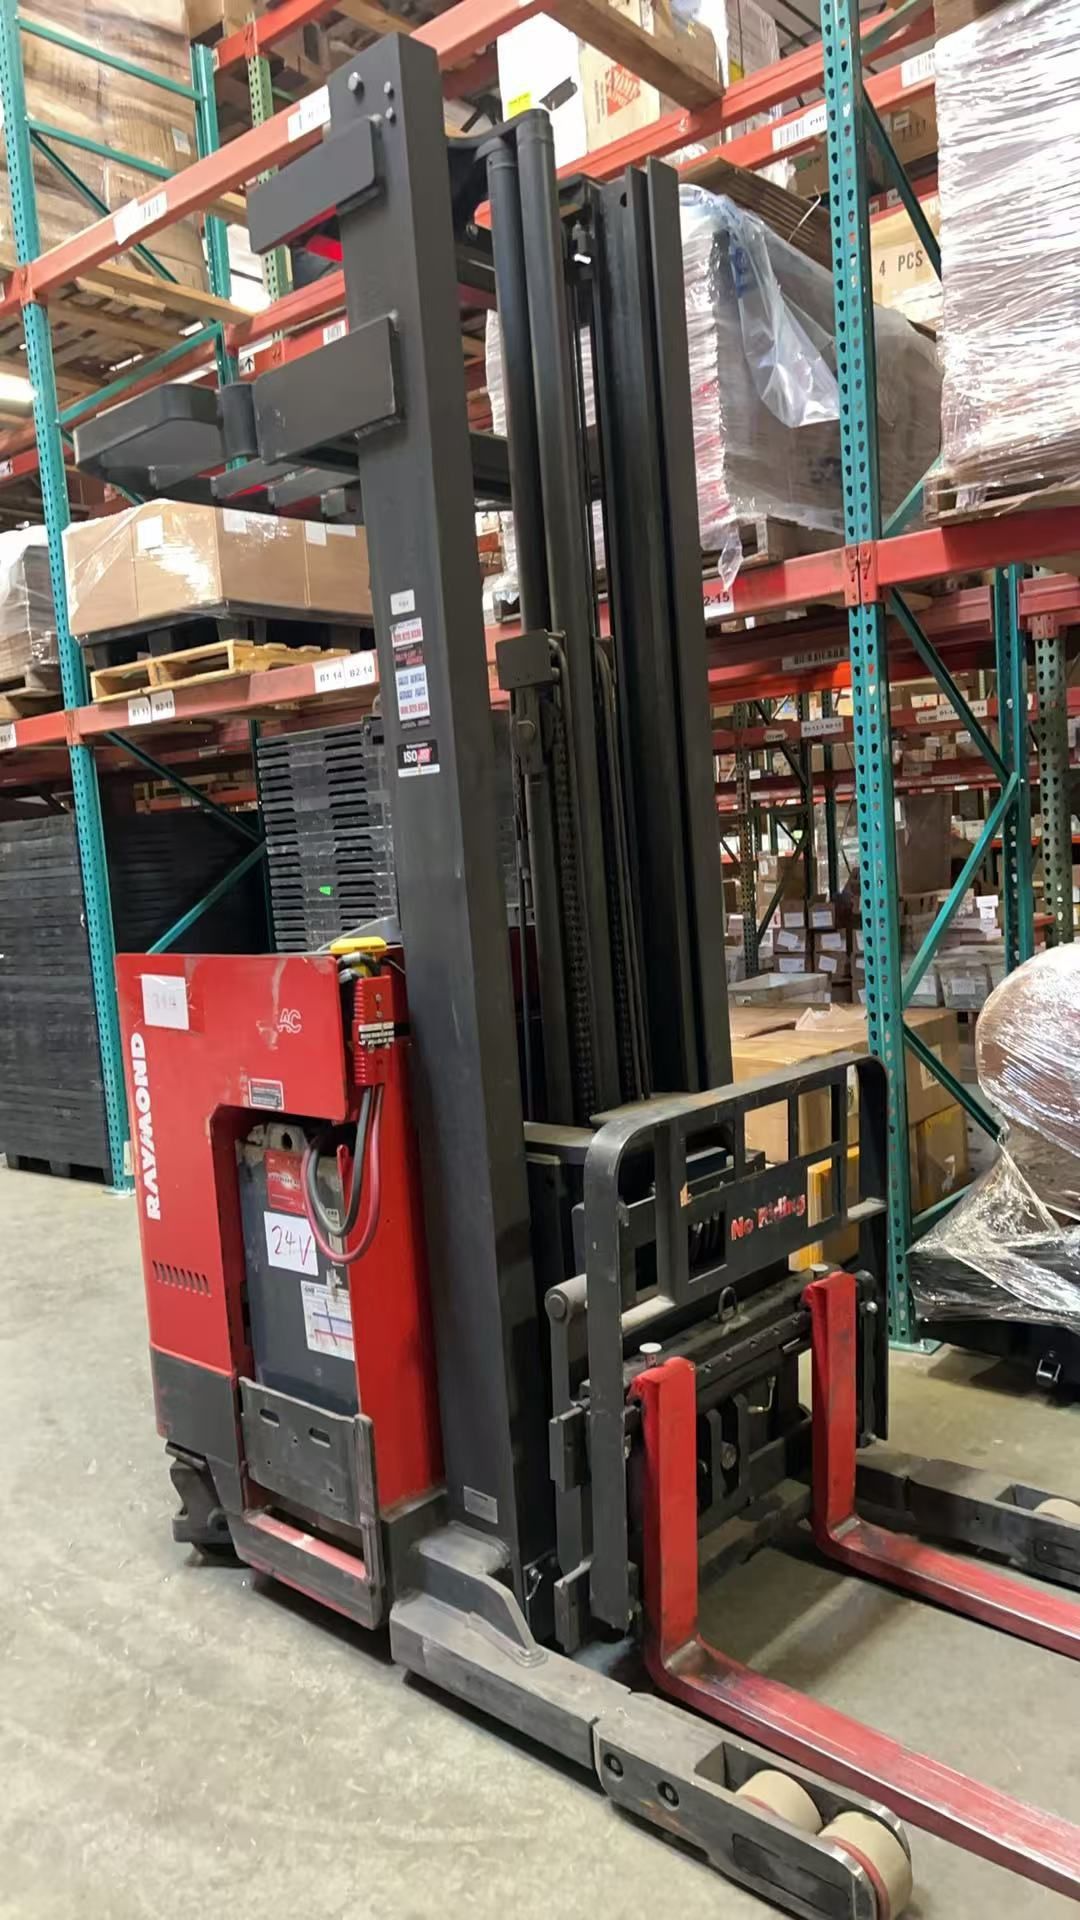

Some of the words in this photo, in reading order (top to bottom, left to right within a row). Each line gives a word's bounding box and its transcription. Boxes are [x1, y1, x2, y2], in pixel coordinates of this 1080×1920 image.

[878, 259, 887, 277] 4
[897, 250, 924, 272] PCS
[403, 750, 418, 763] ISO
[277, 1008, 302, 1033] AC
[131, 1031, 161, 1220] RAYMOND
[730, 1216, 754, 1241] No
[757, 1194, 806, 1229] Riding
